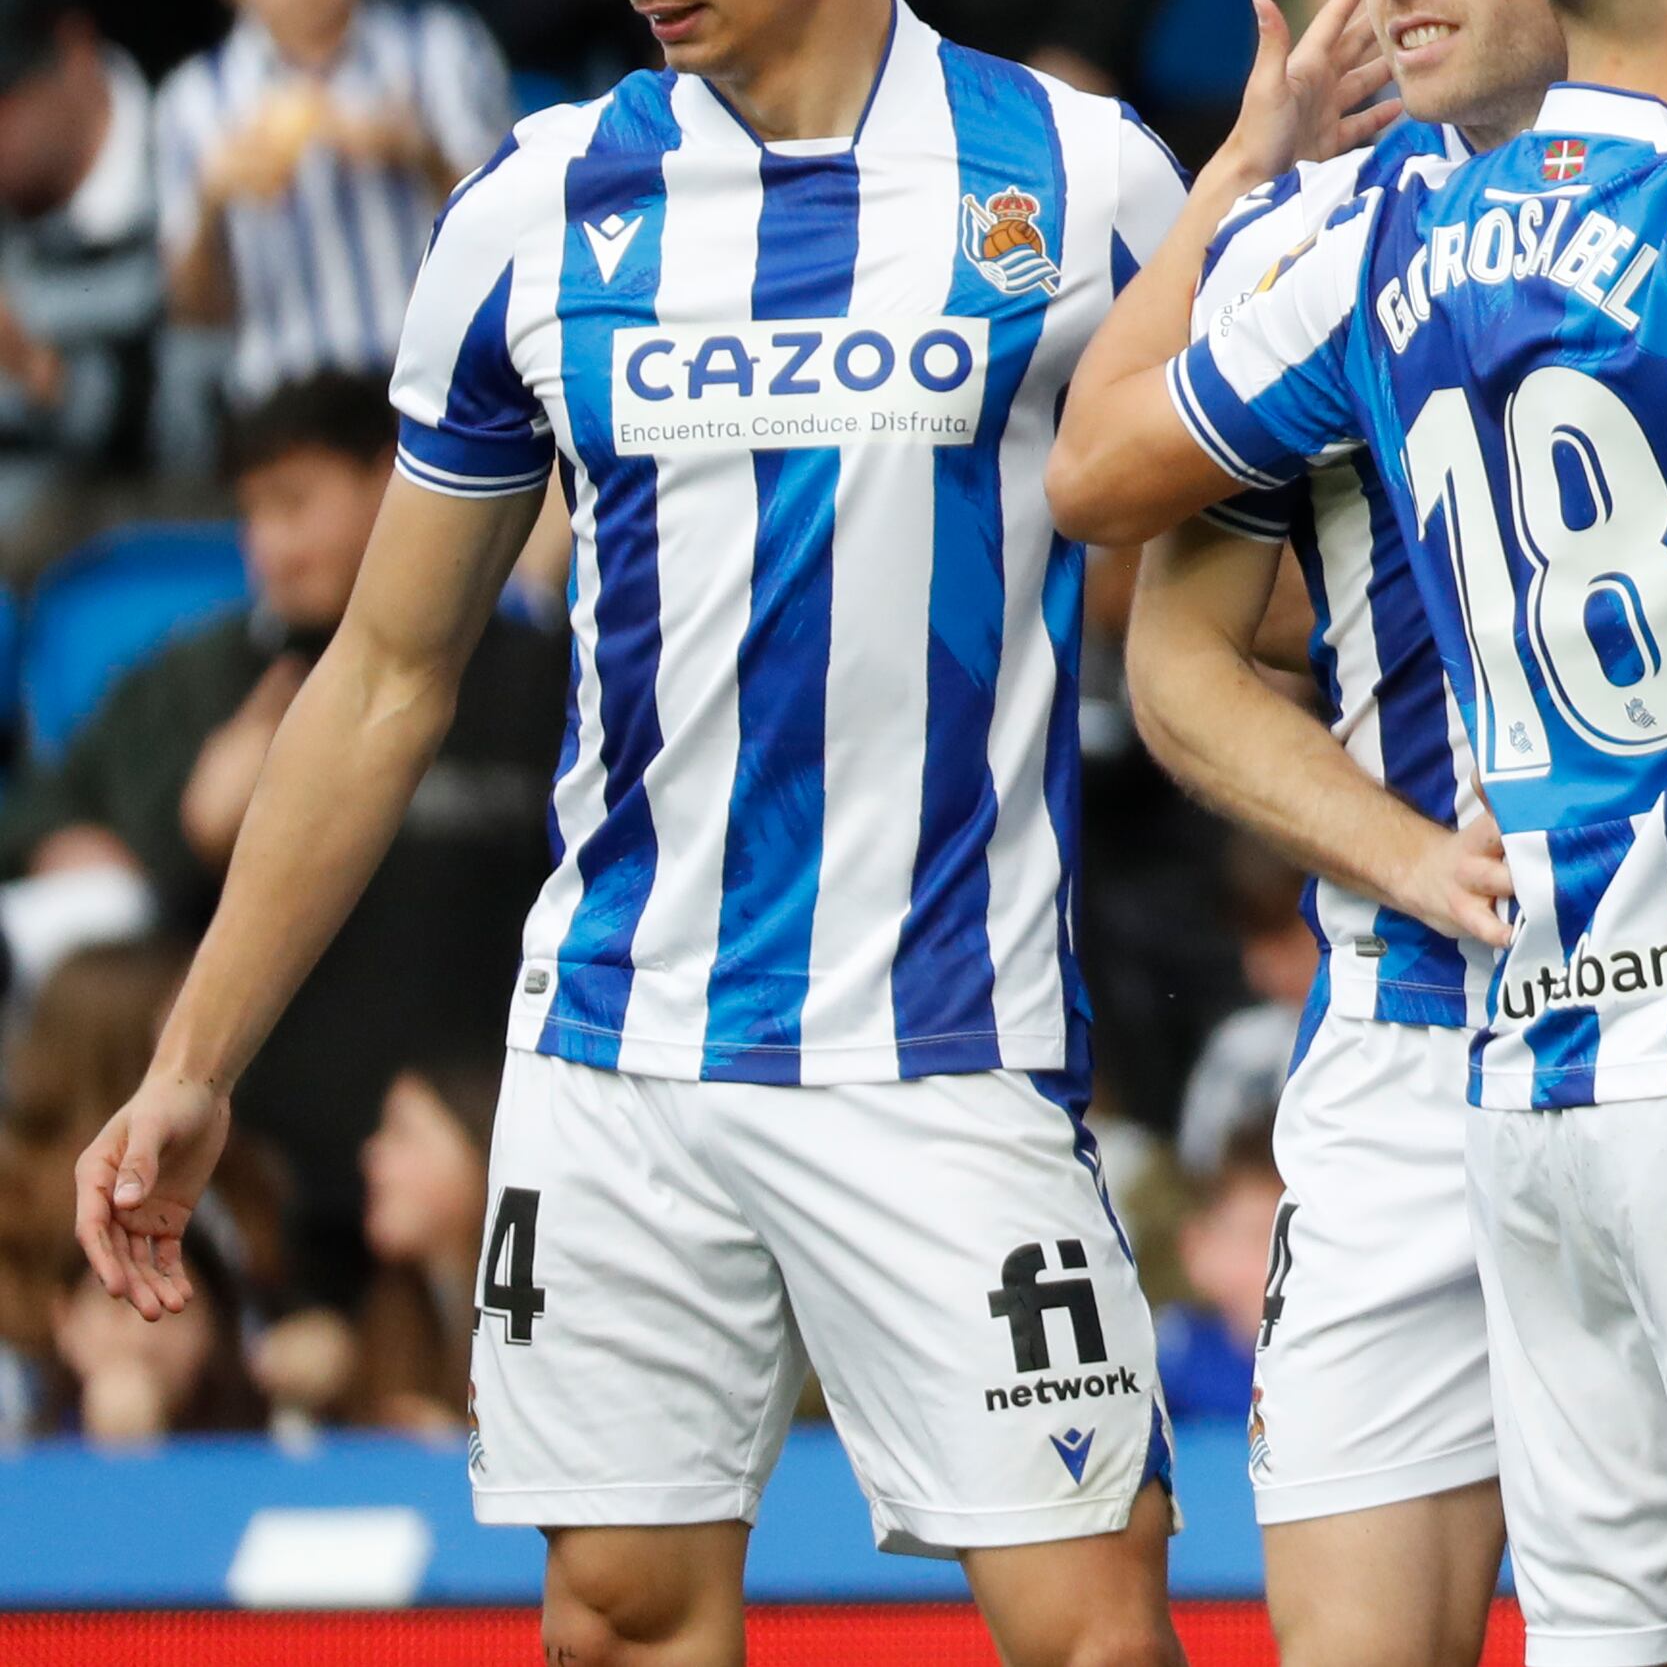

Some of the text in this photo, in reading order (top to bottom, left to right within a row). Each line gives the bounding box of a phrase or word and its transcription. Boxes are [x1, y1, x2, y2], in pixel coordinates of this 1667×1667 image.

[1376, 198, 1658, 354] GOROSABEL
[626, 329, 973, 401] CAZOO
[620, 410, 970, 443] Encuentra. Conduce. Disfruta.
[473, 1186, 546, 1347] 4
[987, 1239, 1109, 1373] fi
[985, 1366, 1141, 1412] network
